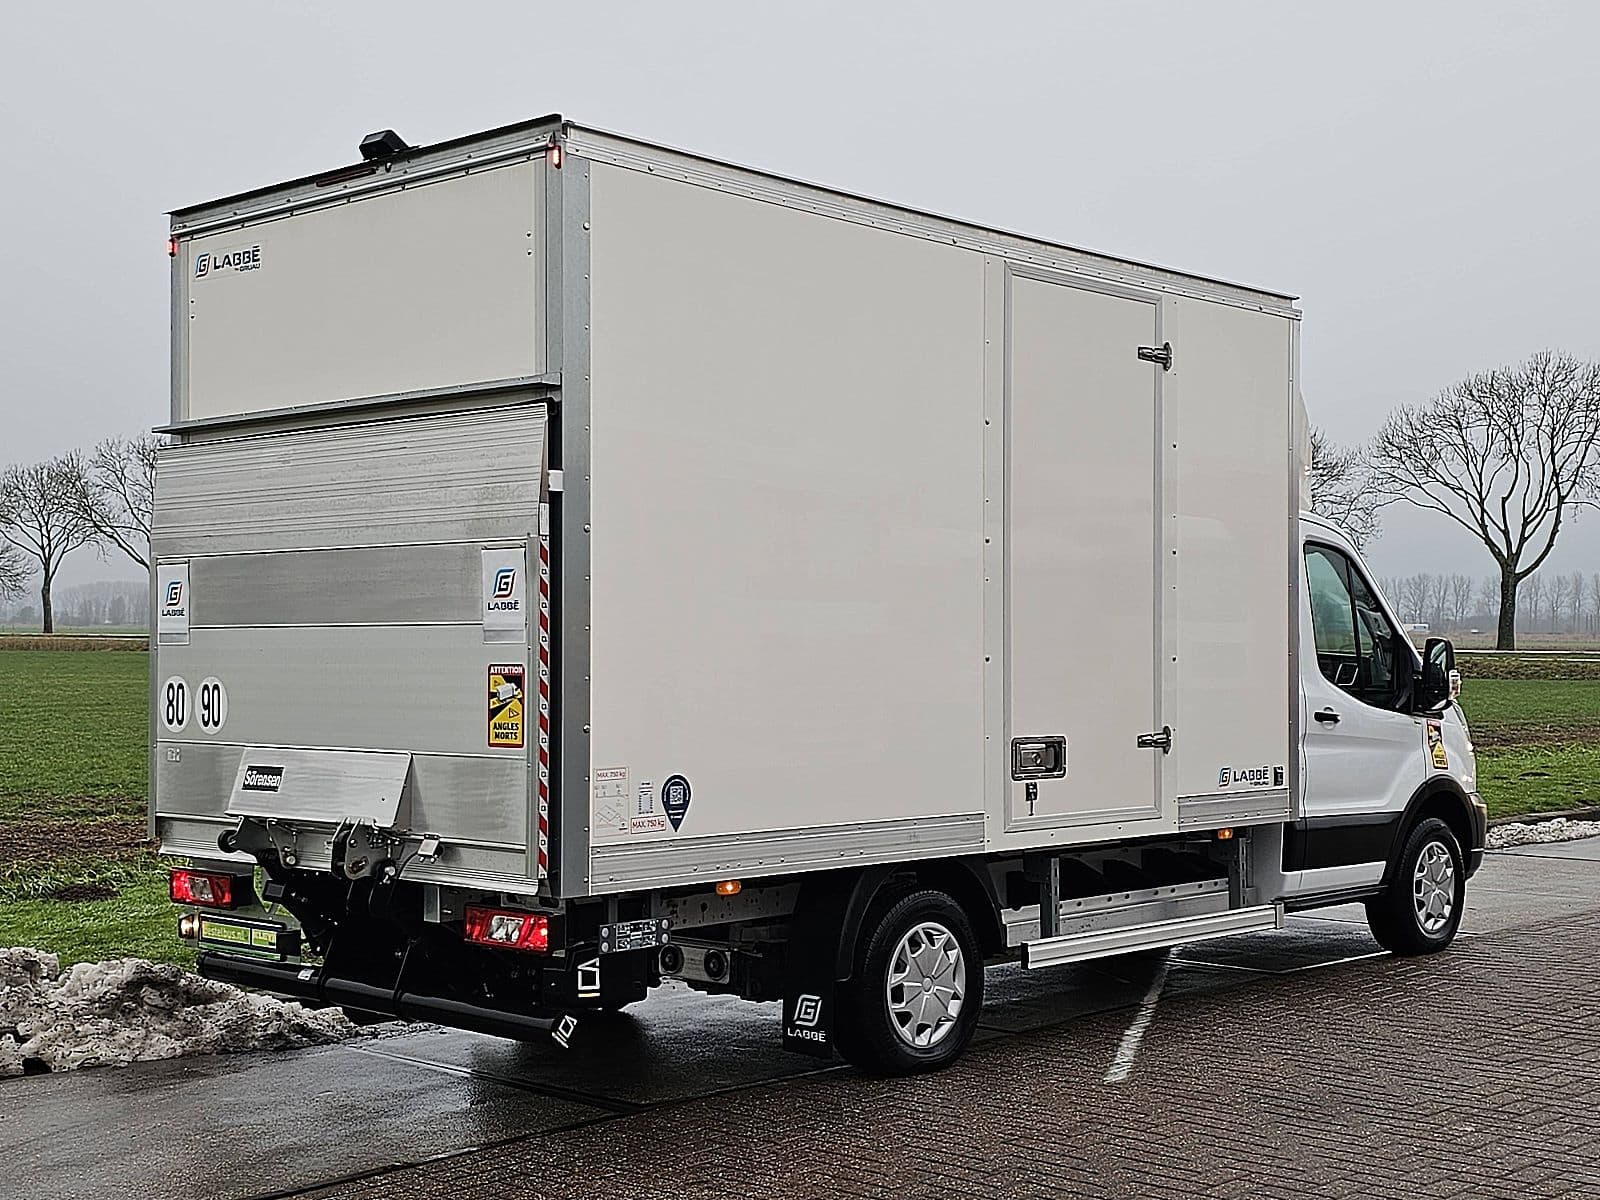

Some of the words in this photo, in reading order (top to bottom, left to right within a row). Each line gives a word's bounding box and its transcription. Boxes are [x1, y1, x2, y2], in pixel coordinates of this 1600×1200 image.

[490, 666, 522, 674] ATTENTION
[166, 682, 185, 726] 80
[201, 683, 221, 728] 90
[493, 722, 519, 731] ANGLES
[494, 731, 518, 740] MORTS
[244, 770, 281, 787] Sörensen
